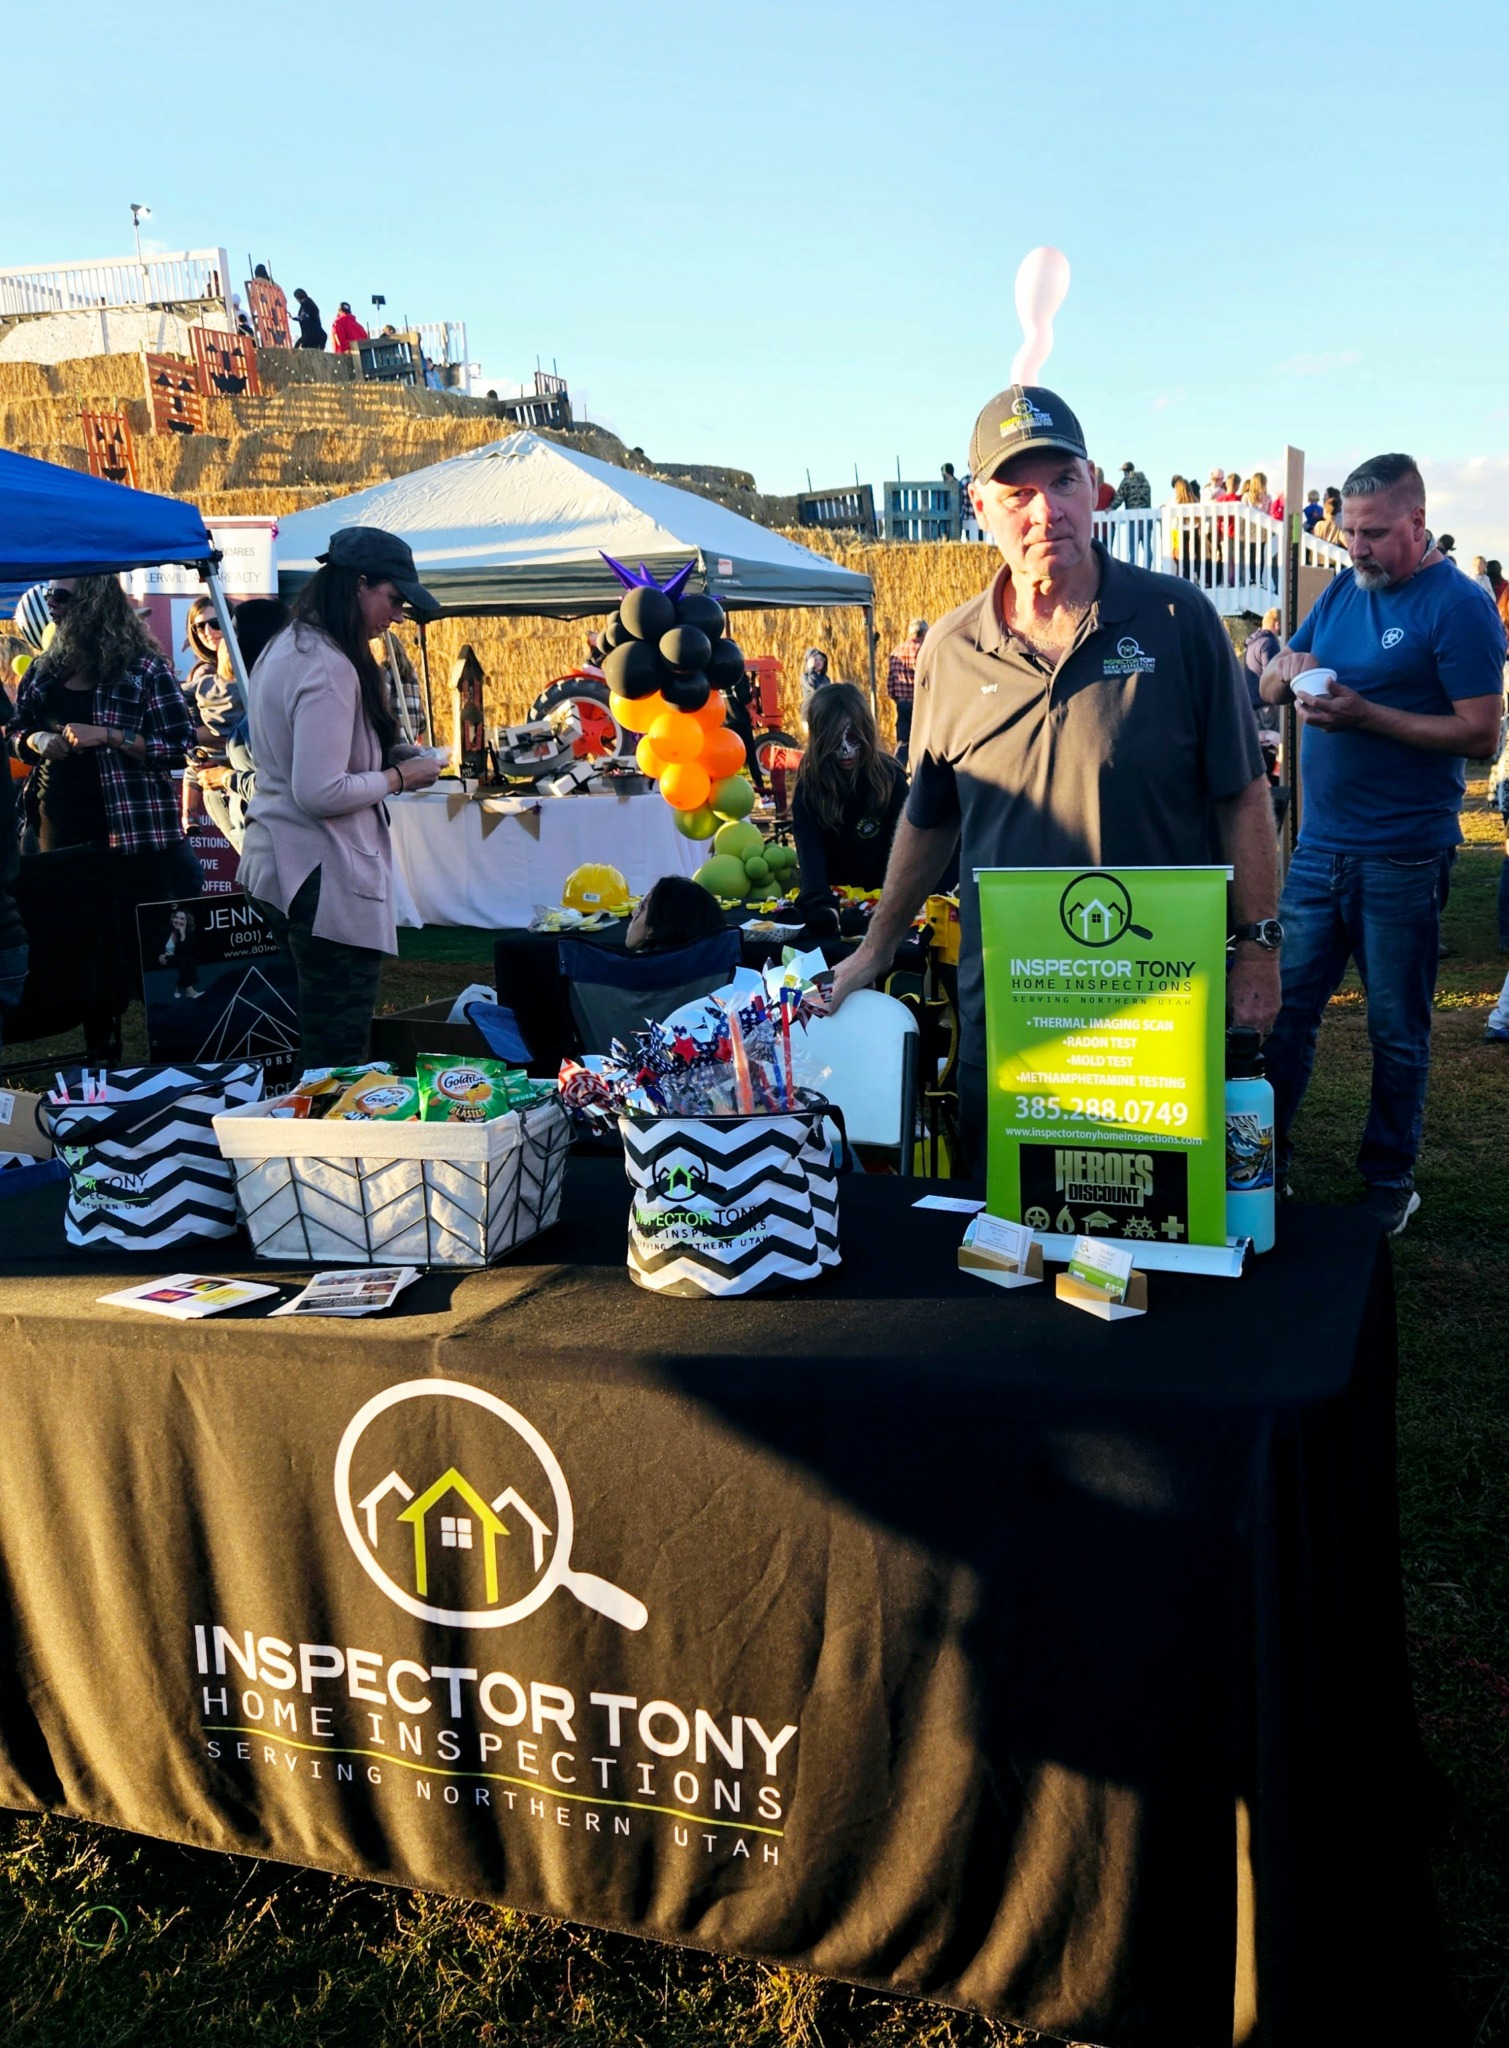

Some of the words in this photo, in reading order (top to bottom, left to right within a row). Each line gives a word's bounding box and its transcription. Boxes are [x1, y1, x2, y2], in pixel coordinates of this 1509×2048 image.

[220, 547, 255, 557] NDARIES
[190, 836, 230, 849] ESTIONS
[200, 859, 219, 870] OVE
[204, 904, 264, 931] JENN
[230, 929, 262, 947] (801)
[224, 944, 280, 958] www.801re
[1010, 959, 1131, 978] INSPECTOR
[1136, 960, 1196, 978] TONY
[1012, 978, 1056, 989] HOME
[1065, 979, 1192, 992] INSPECTIONS
[1012, 995, 1069, 1004] SERVING
[1081, 996, 1147, 1005] NORTHERN
[1033, 1016, 1087, 1029] THERMAL
[1089, 1018, 1141, 1031] IMAGING
[1143, 1019, 1174, 1032] SCAN
[1110, 1037, 1137, 1049] TEST
[1107, 1056, 1134, 1068] TEST
[1138, 1075, 1186, 1089] TESTING
[1015, 1095, 1188, 1127] 385.288.0749
[1005, 1127, 1202, 1145] www.inspectortonyhomeinspections.com
[1055, 1149, 1154, 1196] HEROES
[1068, 1183, 1140, 1205] DISCOUNT
[194, 1624, 577, 1742] INSPECTOR
[589, 1692, 798, 1777] TONY
[203, 1686, 335, 1737] HOME
[367, 1712, 783, 1820] INSPECTIONS
[207, 1741, 382, 1784] SERVING
[416, 1780, 630, 1836] NORTHERN
[674, 1825, 779, 1866] UTAH
